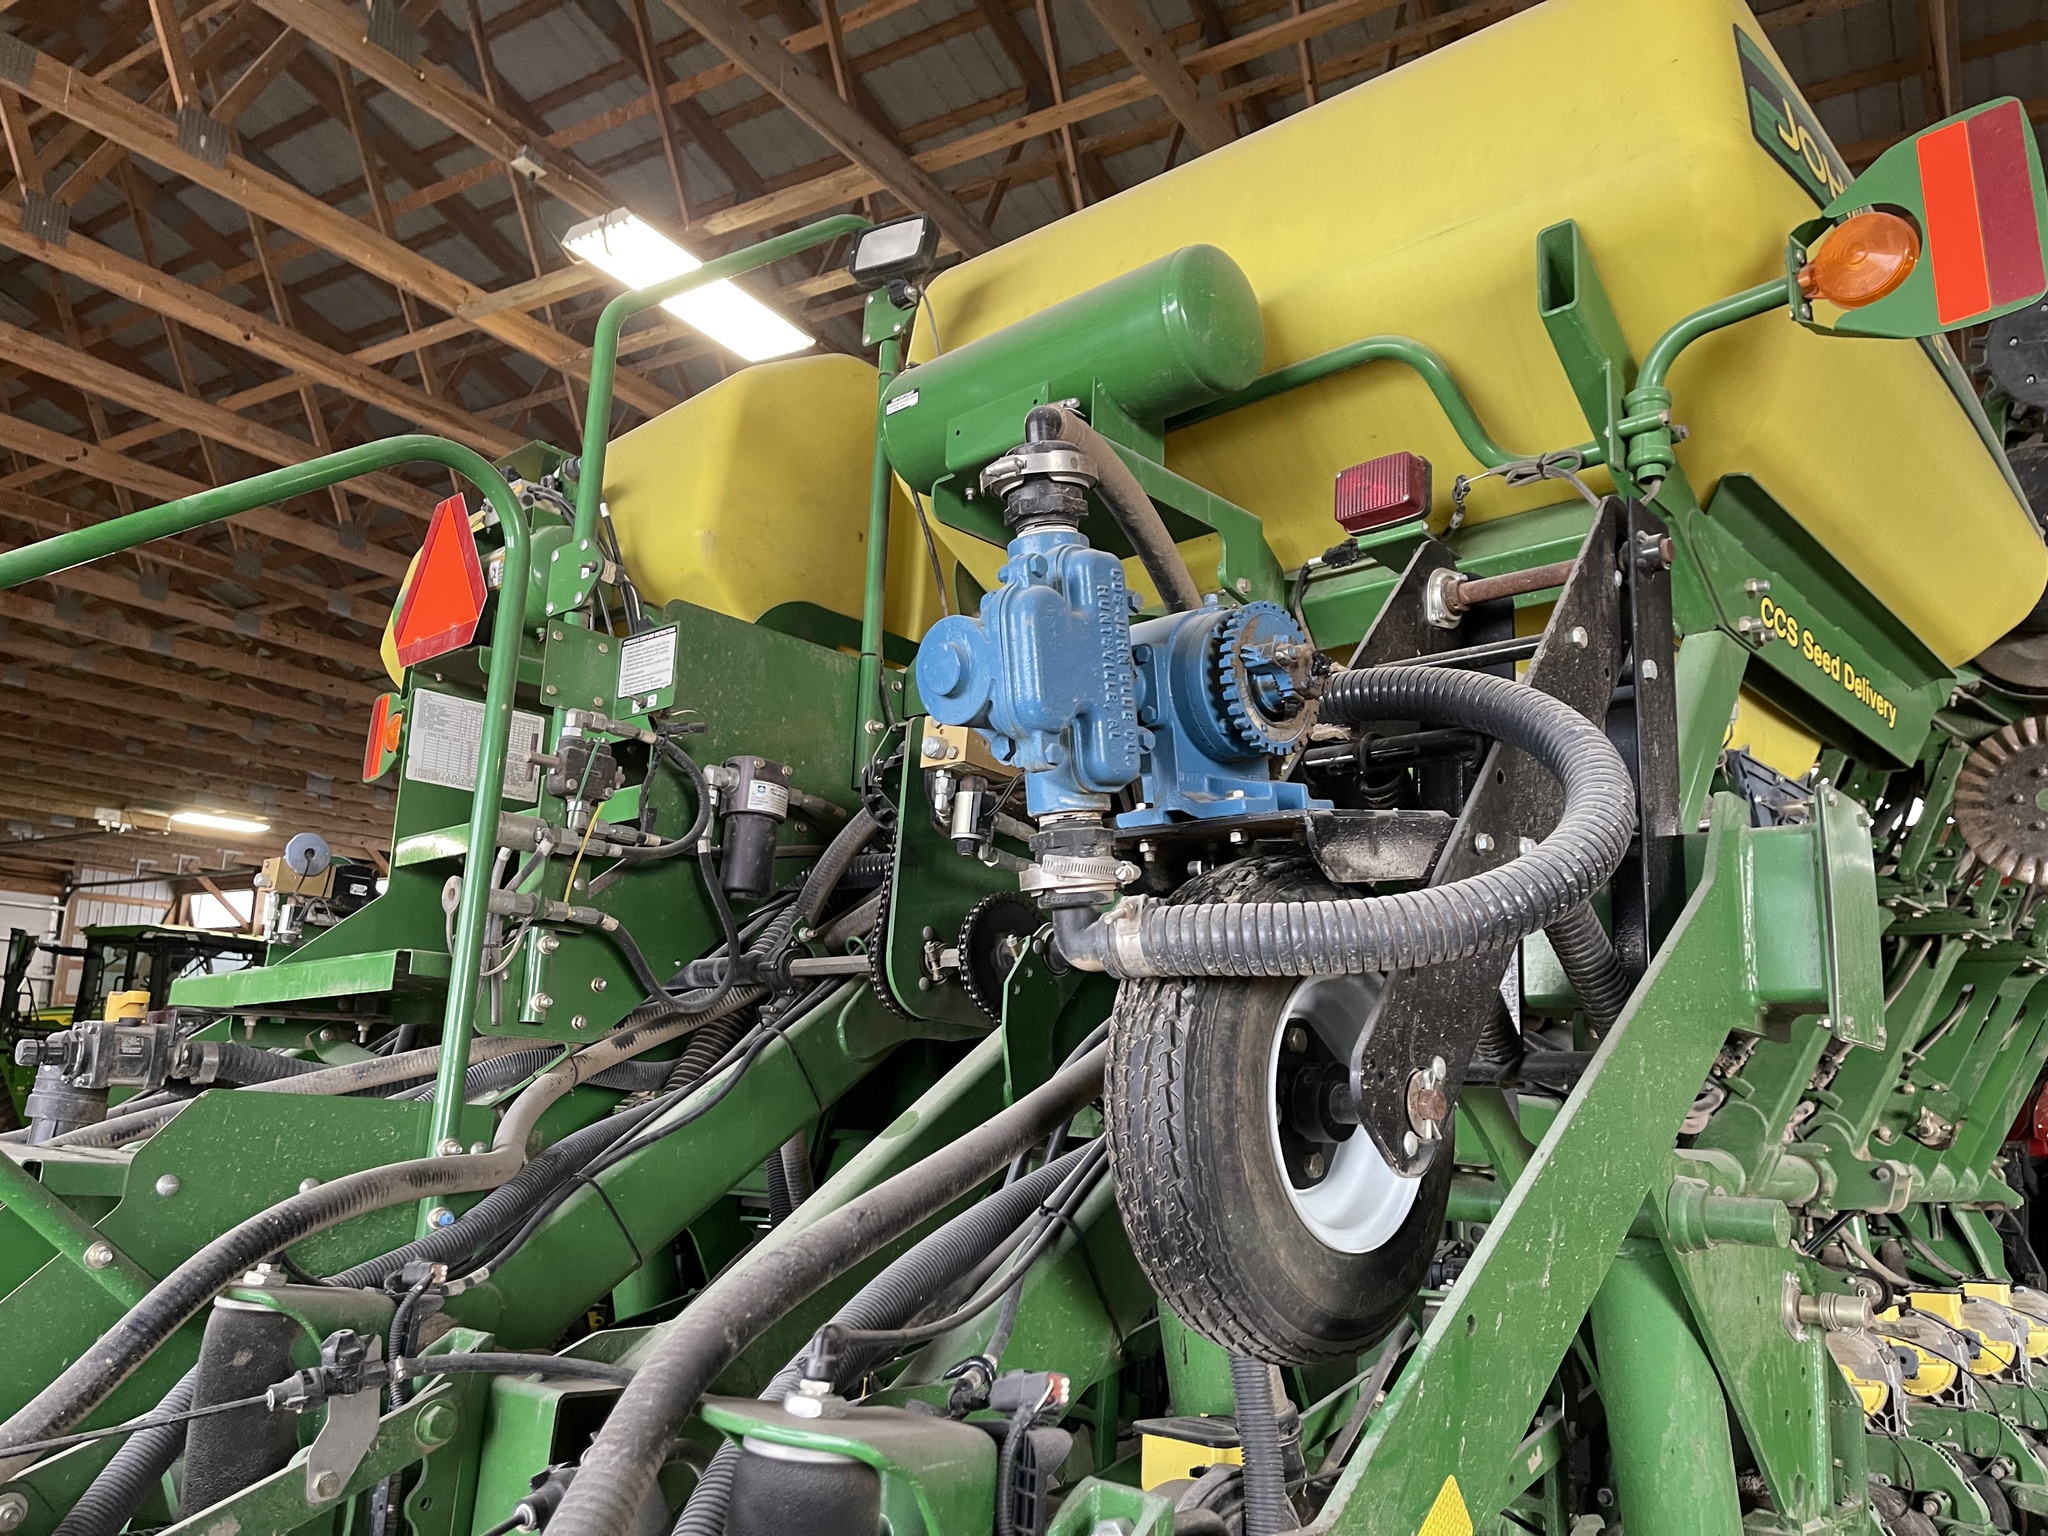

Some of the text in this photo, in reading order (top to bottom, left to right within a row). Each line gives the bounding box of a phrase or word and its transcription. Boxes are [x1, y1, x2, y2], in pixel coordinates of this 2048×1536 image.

[1778, 97, 1848, 200] JOH
[1097, 585, 1121, 741] HUNTSVILLE, AL
[1110, 568, 1130, 665] CDS-JOHN
[1760, 596, 1898, 729] CCS Seed Delivery
[1119, 673, 1135, 721] BLUE
